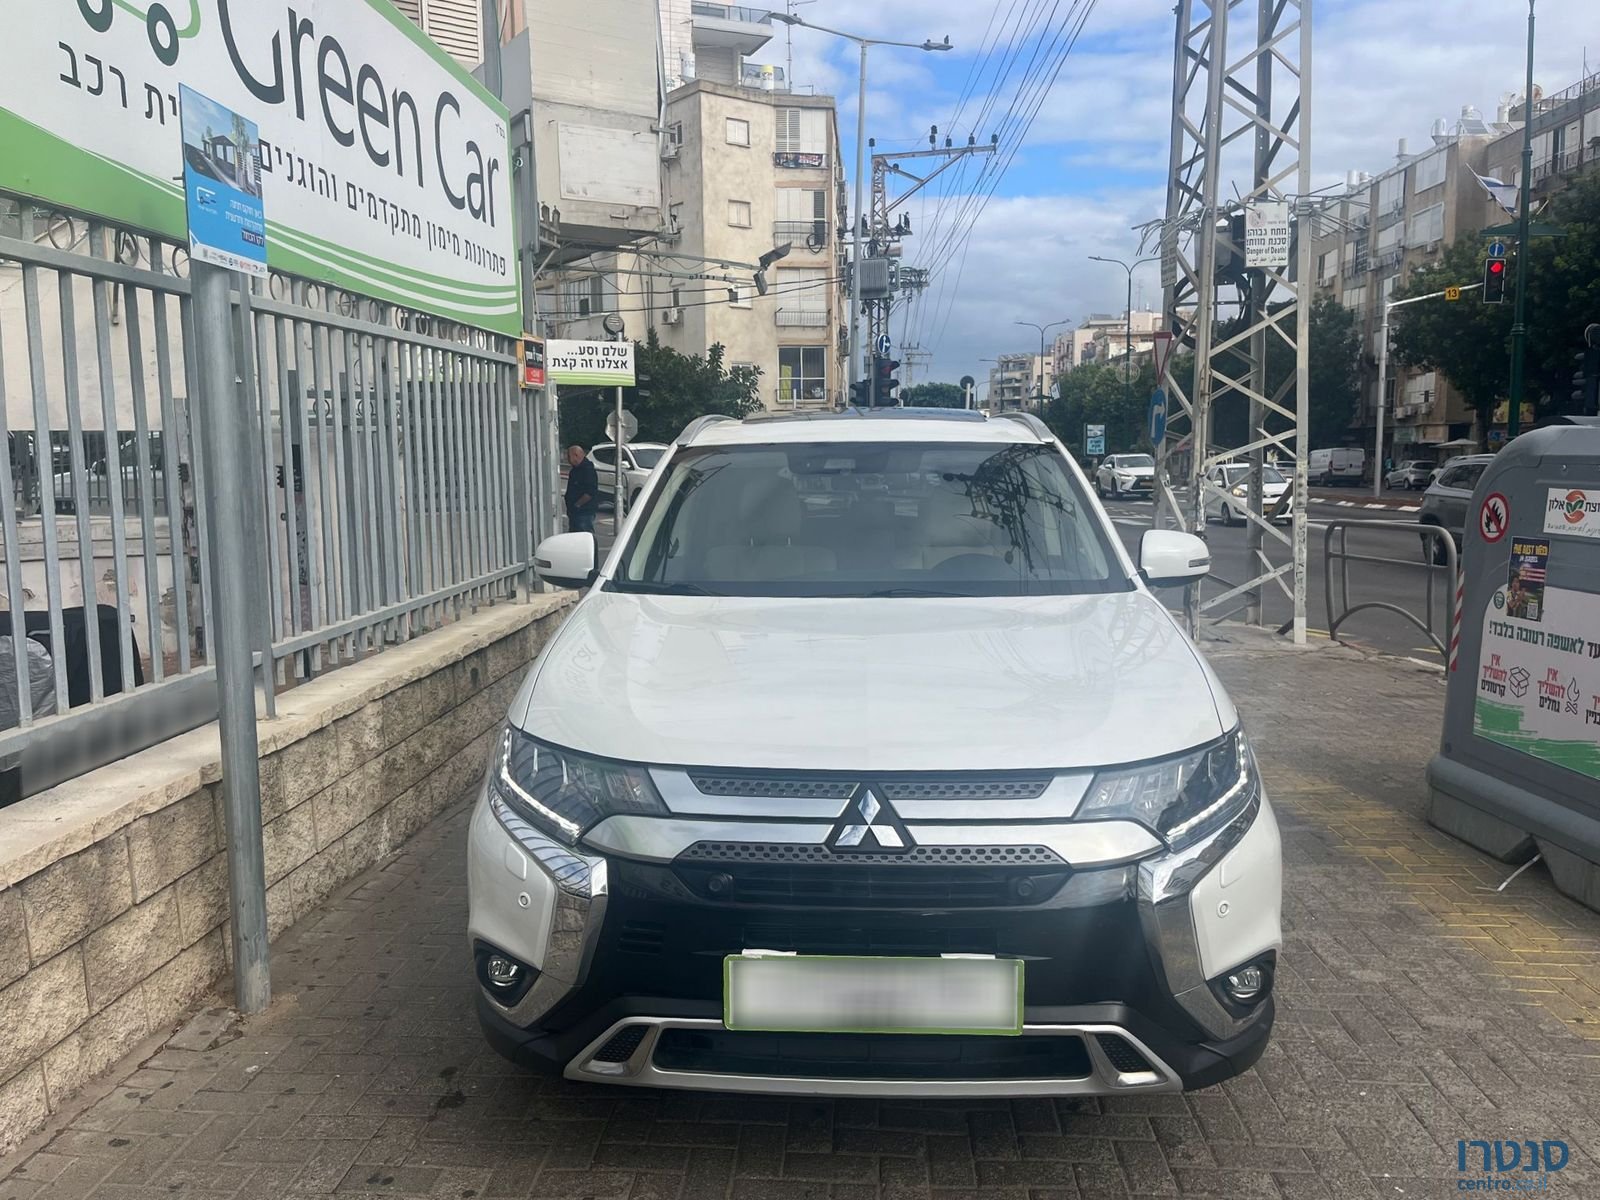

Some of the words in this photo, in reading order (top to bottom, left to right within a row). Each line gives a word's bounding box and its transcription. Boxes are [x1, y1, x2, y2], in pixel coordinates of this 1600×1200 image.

[58, 40, 128, 109] רכב
[434, 91, 499, 228] Car
[258, 138, 338, 202] והוגנים
[346, 181, 422, 240] מתקדמים
[426, 221, 461, 257] מימון
[1247, 228, 1267, 236] גבוה!
[1246, 237, 1265, 246] מוות!
[1267, 237, 1287, 245] סכנת
[464, 239, 506, 277] פתרונות
[1247, 247, 1264, 255] Danger
[1447, 288, 1458, 298] 13
[567, 345, 599, 356] וסע...
[602, 345, 628, 357] שלם
[552, 357, 577, 371] קצת
[580, 358, 594, 369] זה
[597, 357, 628, 370] אצלנו
[1548, 497, 1566, 512] אלון
[1488, 620, 1515, 639] בלבד!
[1516, 626, 1545, 646] רטובה
[1546, 632, 1585, 655] לאשפה
[1491, 653, 1501, 667] אין
[1483, 665, 1508, 683] להשליך
[1546, 667, 1559, 681] אין
[1481, 678, 1506, 698] קרטונים
[1537, 680, 1566, 699] להשליך
[1539, 695, 1561, 713] גחלים
